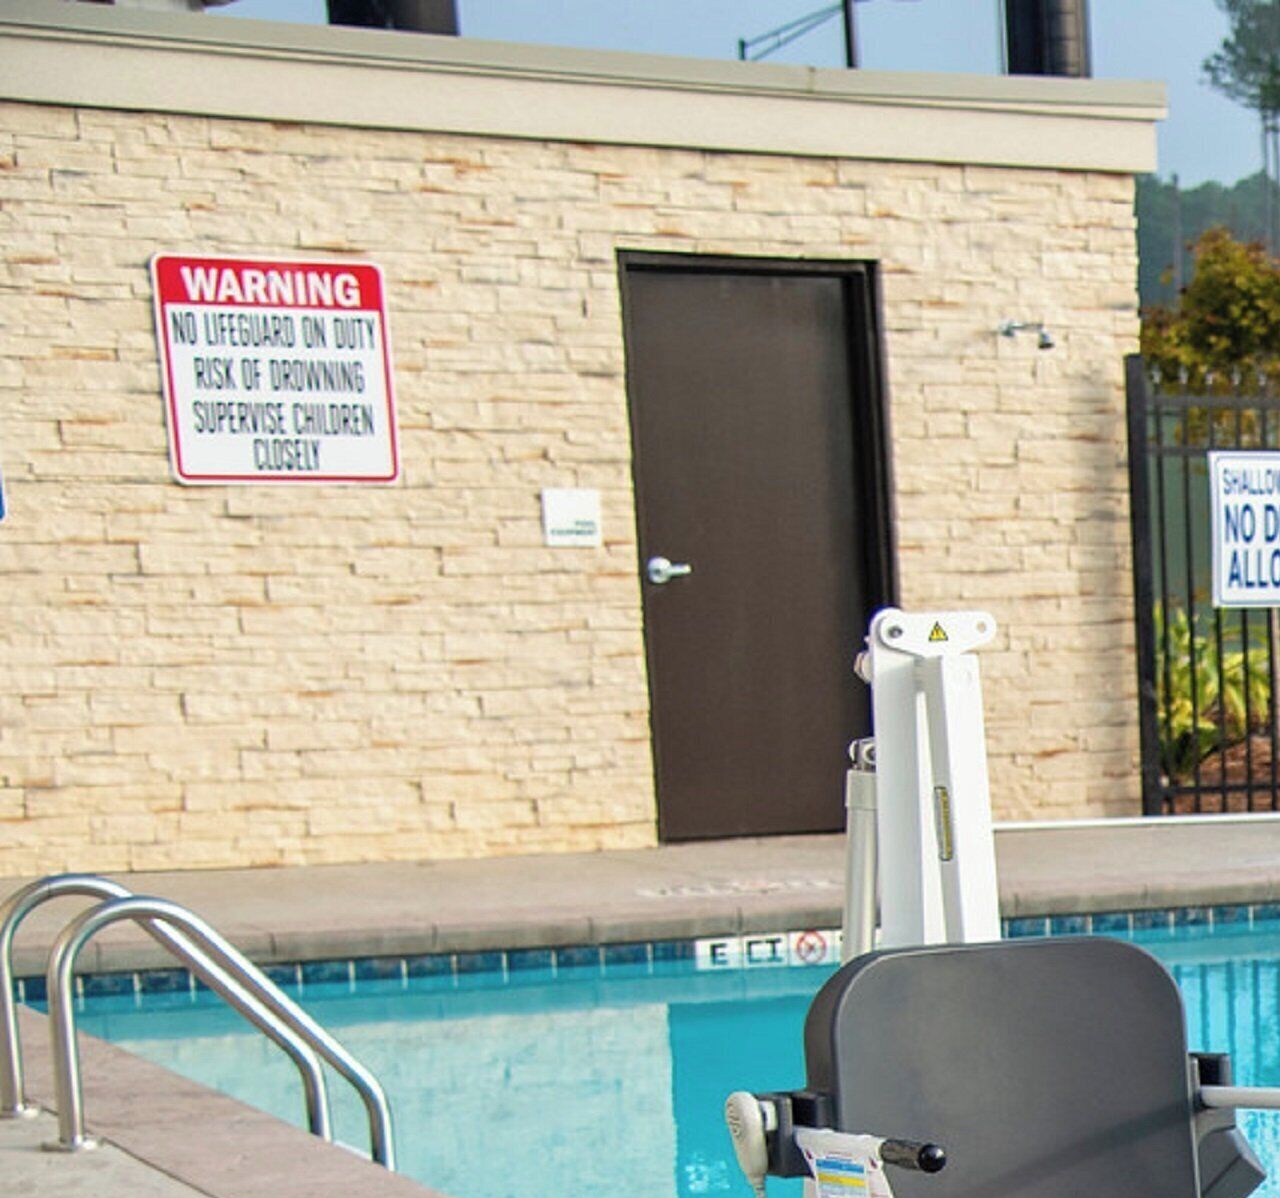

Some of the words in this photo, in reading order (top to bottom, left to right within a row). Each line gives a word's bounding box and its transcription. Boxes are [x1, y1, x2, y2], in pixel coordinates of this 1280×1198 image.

[180, 266, 361, 306] WARNING
[171, 311, 198, 345] NO
[204, 312, 296, 348] LIFEGUARD
[302, 317, 327, 349] ON
[334, 318, 375, 350] DUTY
[193, 358, 236, 390] RISK
[242, 359, 262, 391] OF
[271, 360, 365, 394] DROWNING
[193, 401, 286, 435] SUPERVISE
[293, 403, 375, 436] CHILDREN
[253, 439, 320, 471] CLOSELY
[1224, 504, 1256, 543] NO
